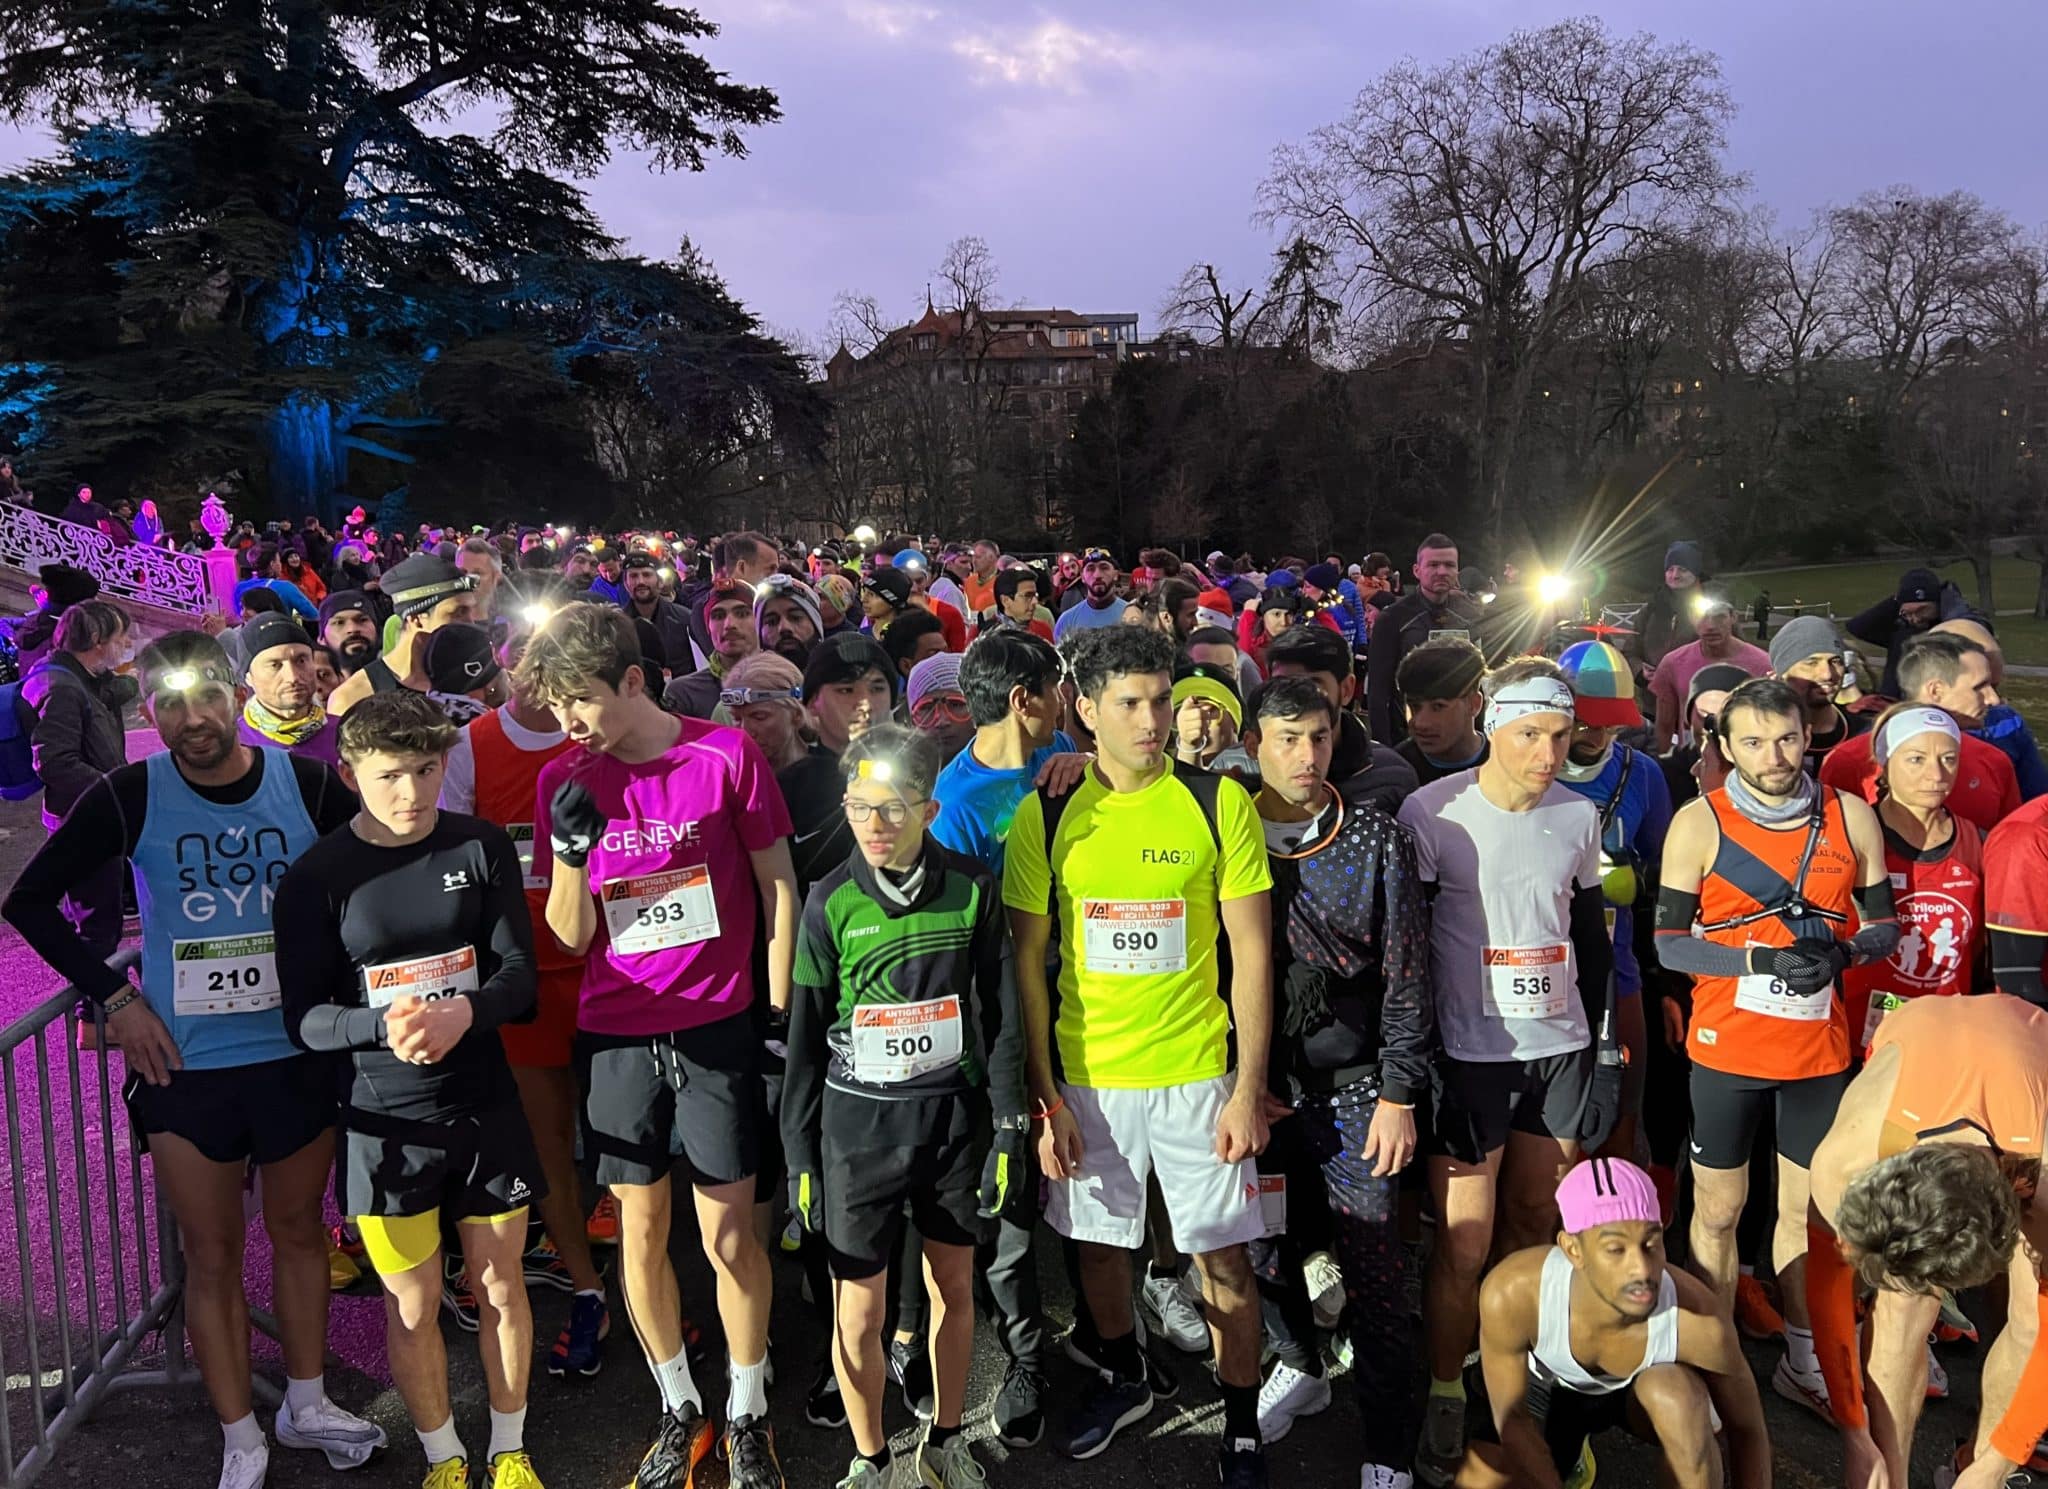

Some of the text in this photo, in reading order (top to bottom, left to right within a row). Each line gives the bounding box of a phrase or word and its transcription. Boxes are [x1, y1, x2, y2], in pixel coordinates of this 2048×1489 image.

[1142, 849, 1195, 865] FLAG21
[637, 902, 685, 926] 593
[1113, 904, 1149, 912] ANTIGEL
[1907, 902, 1955, 915] Trilogie
[1096, 920, 1173, 930] NAWEED AHMAD
[208, 940, 251, 951] ANTIGEL
[1112, 931, 1159, 951] 690
[207, 966, 261, 992] 210
[1512, 976, 1551, 996] 536
[884, 1024, 931, 1037] MATHIEU
[885, 1035, 933, 1057] 500
